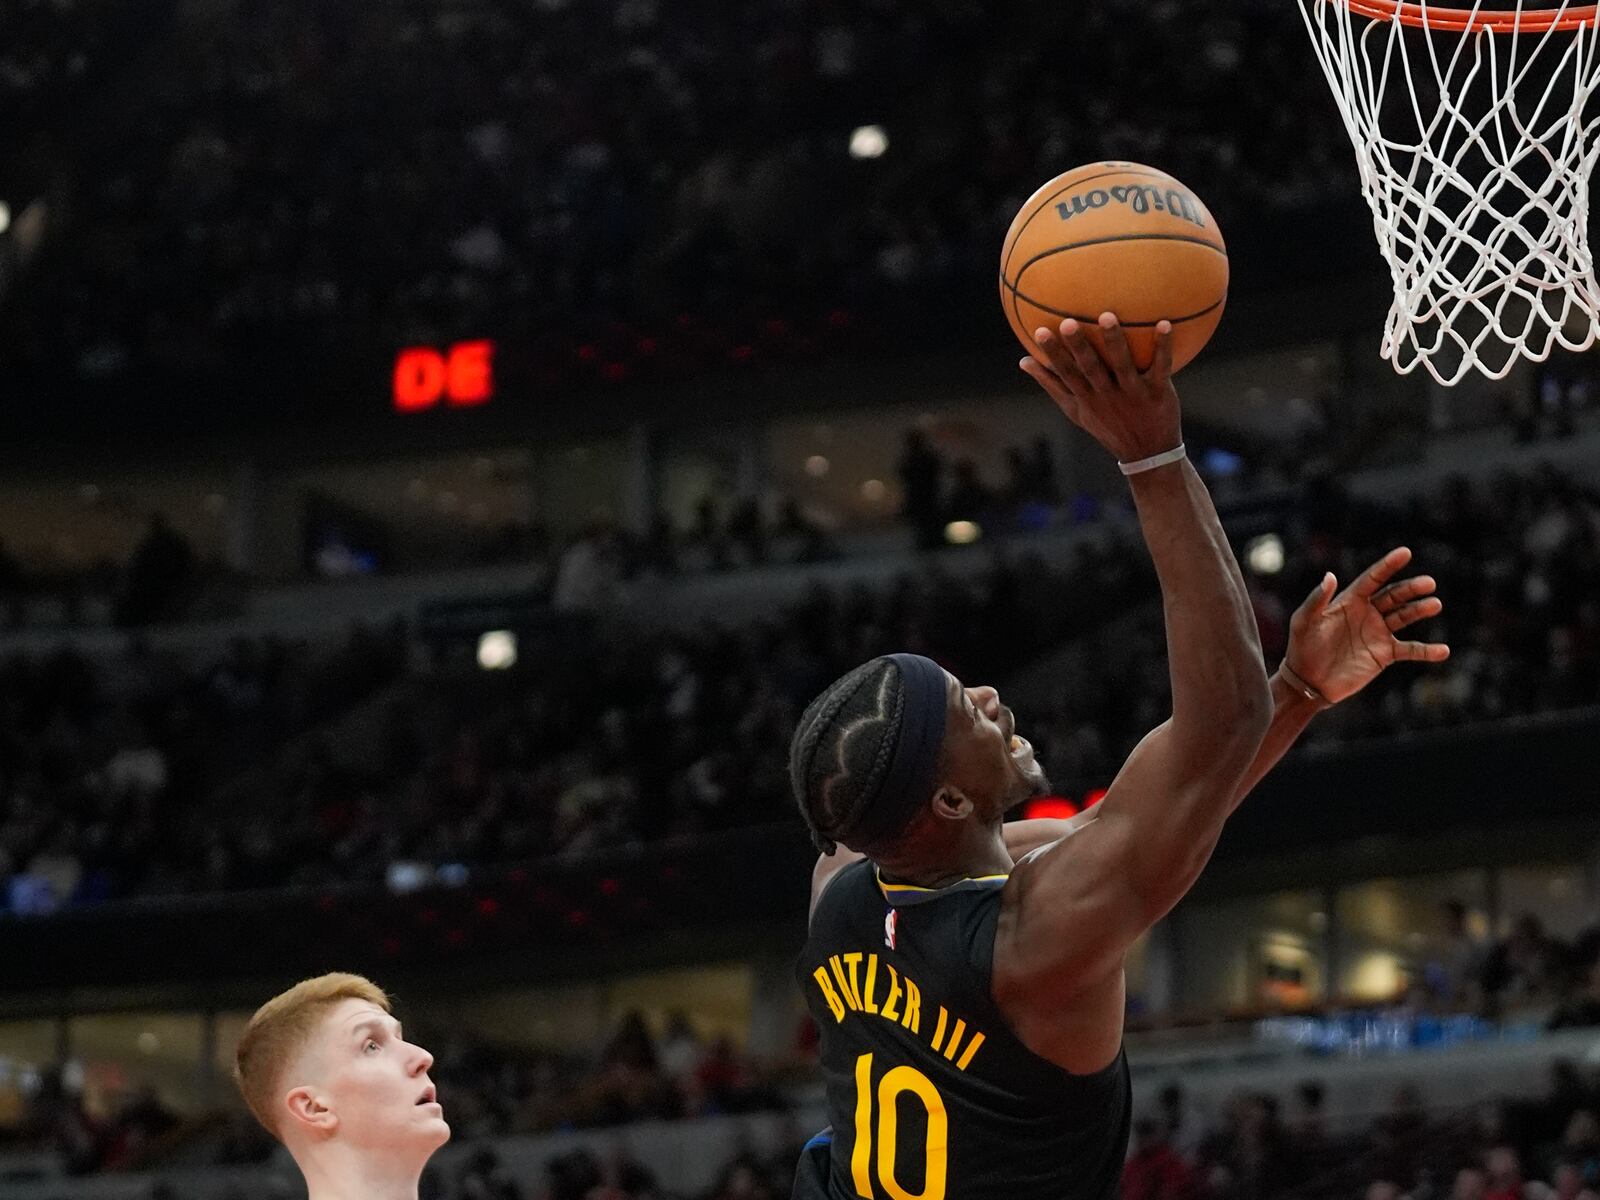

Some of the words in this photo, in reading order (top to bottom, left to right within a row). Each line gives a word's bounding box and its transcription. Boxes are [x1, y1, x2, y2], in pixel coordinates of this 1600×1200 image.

[1055, 184, 1205, 228] Wilson
[814, 952, 921, 1034] BUTLER
[931, 1005, 986, 1071] III
